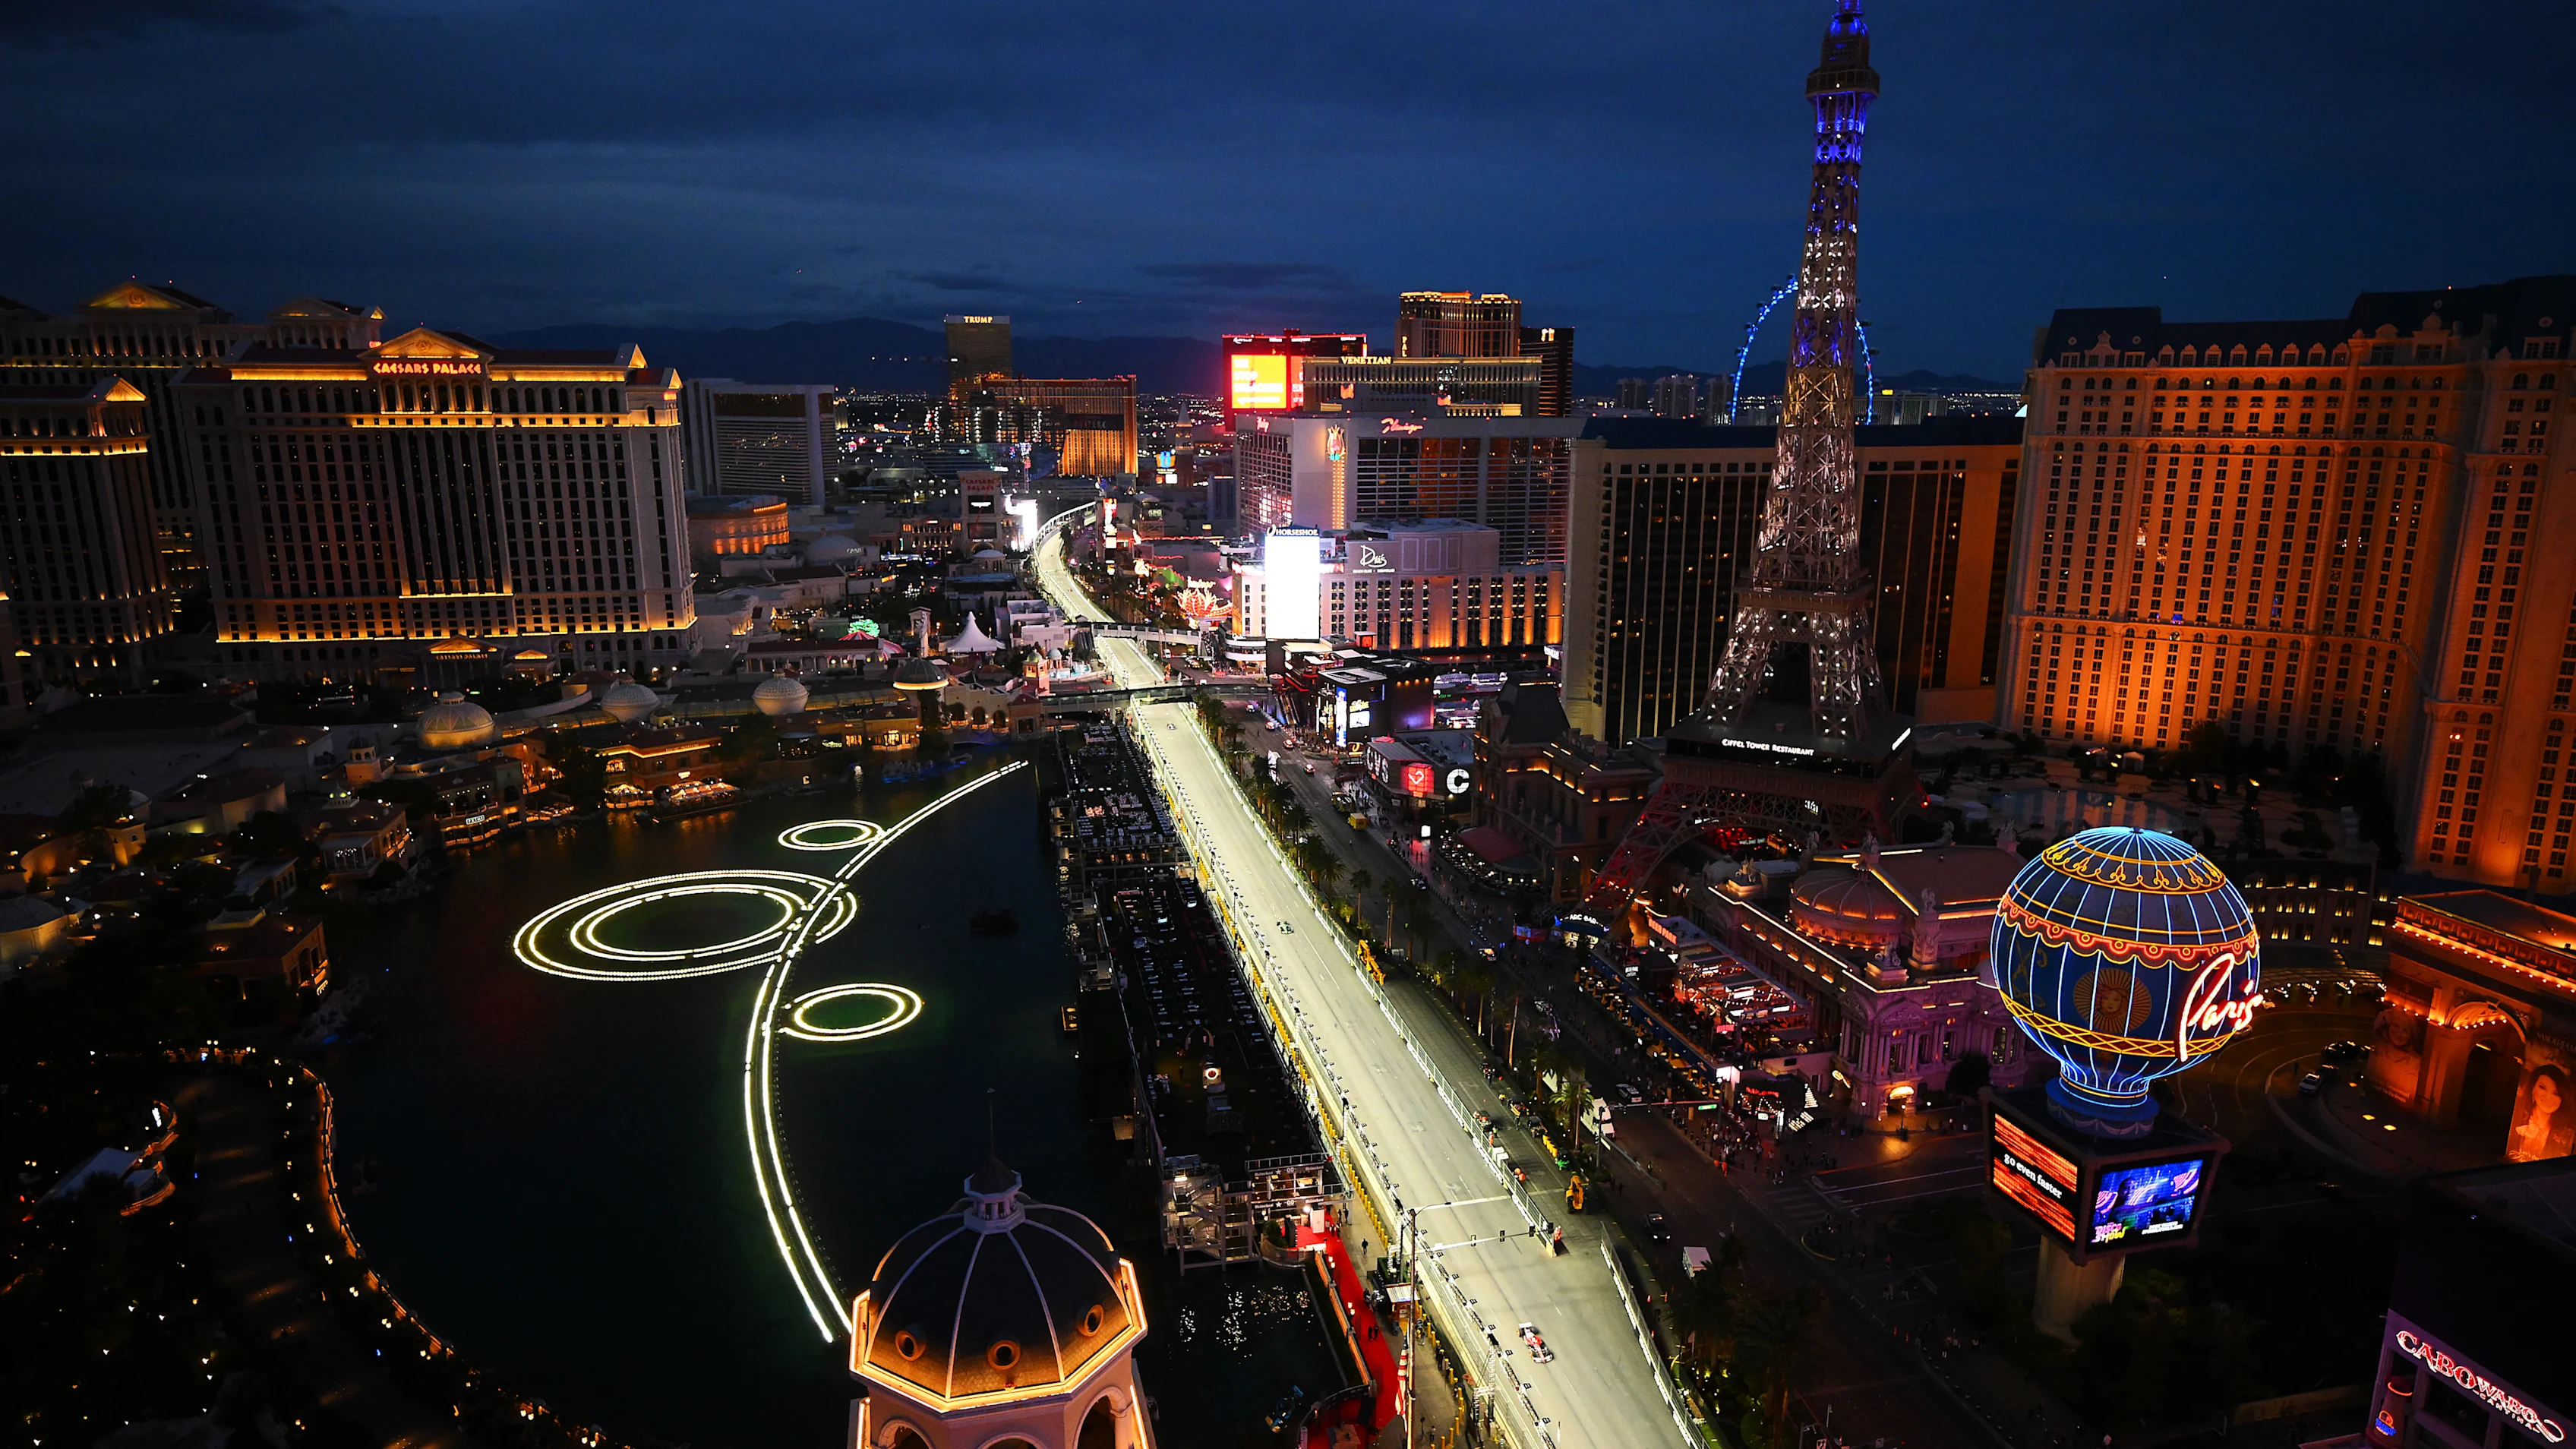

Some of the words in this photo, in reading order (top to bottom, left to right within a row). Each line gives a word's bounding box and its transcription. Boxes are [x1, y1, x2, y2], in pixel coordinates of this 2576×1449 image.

[372, 362, 430, 374] CAESARS
[432, 362, 482, 374] PALACE
[1340, 356, 1392, 365] VENETIAN
[1381, 417, 1424, 434] Flamingo
[1722, 738, 1745, 748] EIFFEL
[1746, 740, 1770, 751] TOWER
[1772, 744, 1814, 756] RESTAURANT
[1447, 769, 1470, 794] C
[1583, 915, 1597, 924] BAR
[1648, 918, 1662, 935] BEER
[1662, 927, 1677, 945] PARK
[2180, 953, 2264, 1062] Paris
[2004, 1154, 2016, 1166] go
[2016, 1162, 2036, 1182] even
[2037, 1174, 2063, 1199] faster
[2091, 1226, 2129, 1243] SHOW
[2095, 1223, 2122, 1235] DISCO
[2480, 1393, 2534, 1431] CANTINA
